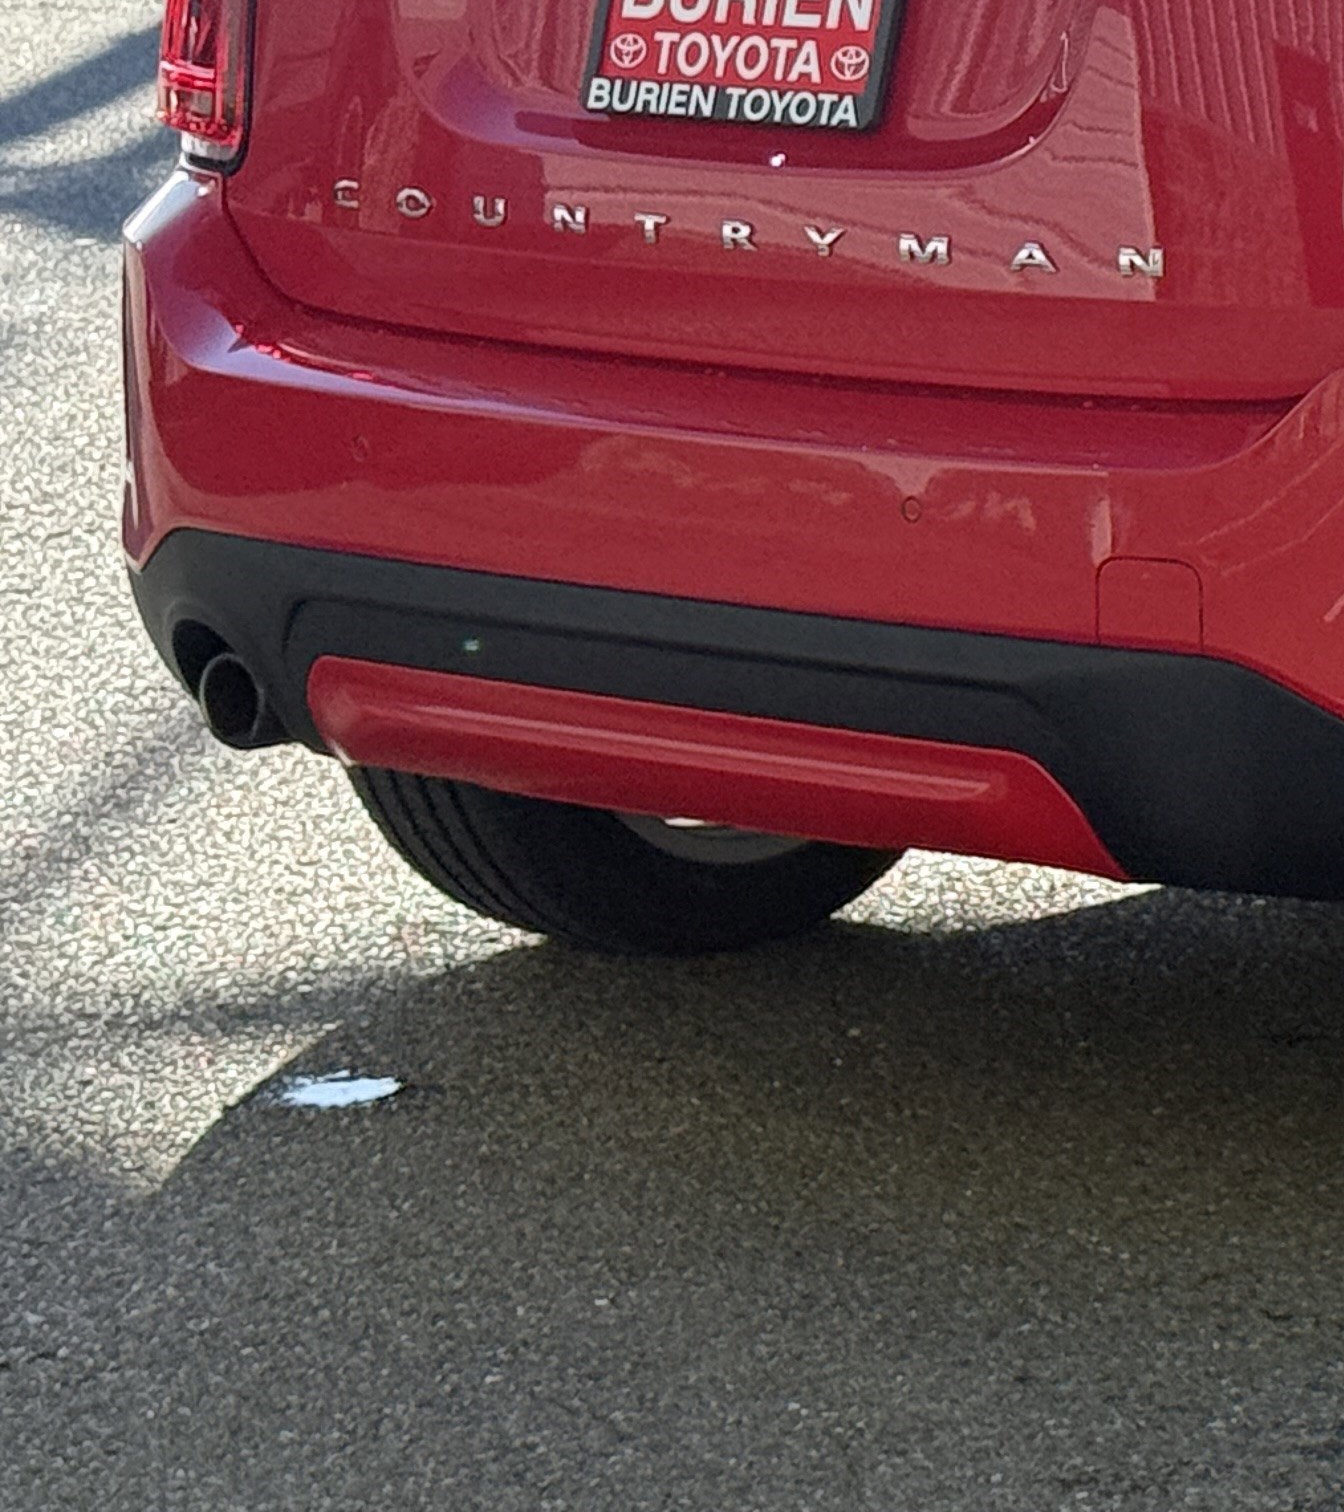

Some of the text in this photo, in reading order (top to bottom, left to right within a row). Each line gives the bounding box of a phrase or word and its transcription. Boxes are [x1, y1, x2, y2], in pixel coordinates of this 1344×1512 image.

[654, 31, 822, 85] TOYOTA
[586, 77, 858, 128] BURIEN TOYOTA
[333, 178, 1164, 277] COUNTRYMAN
